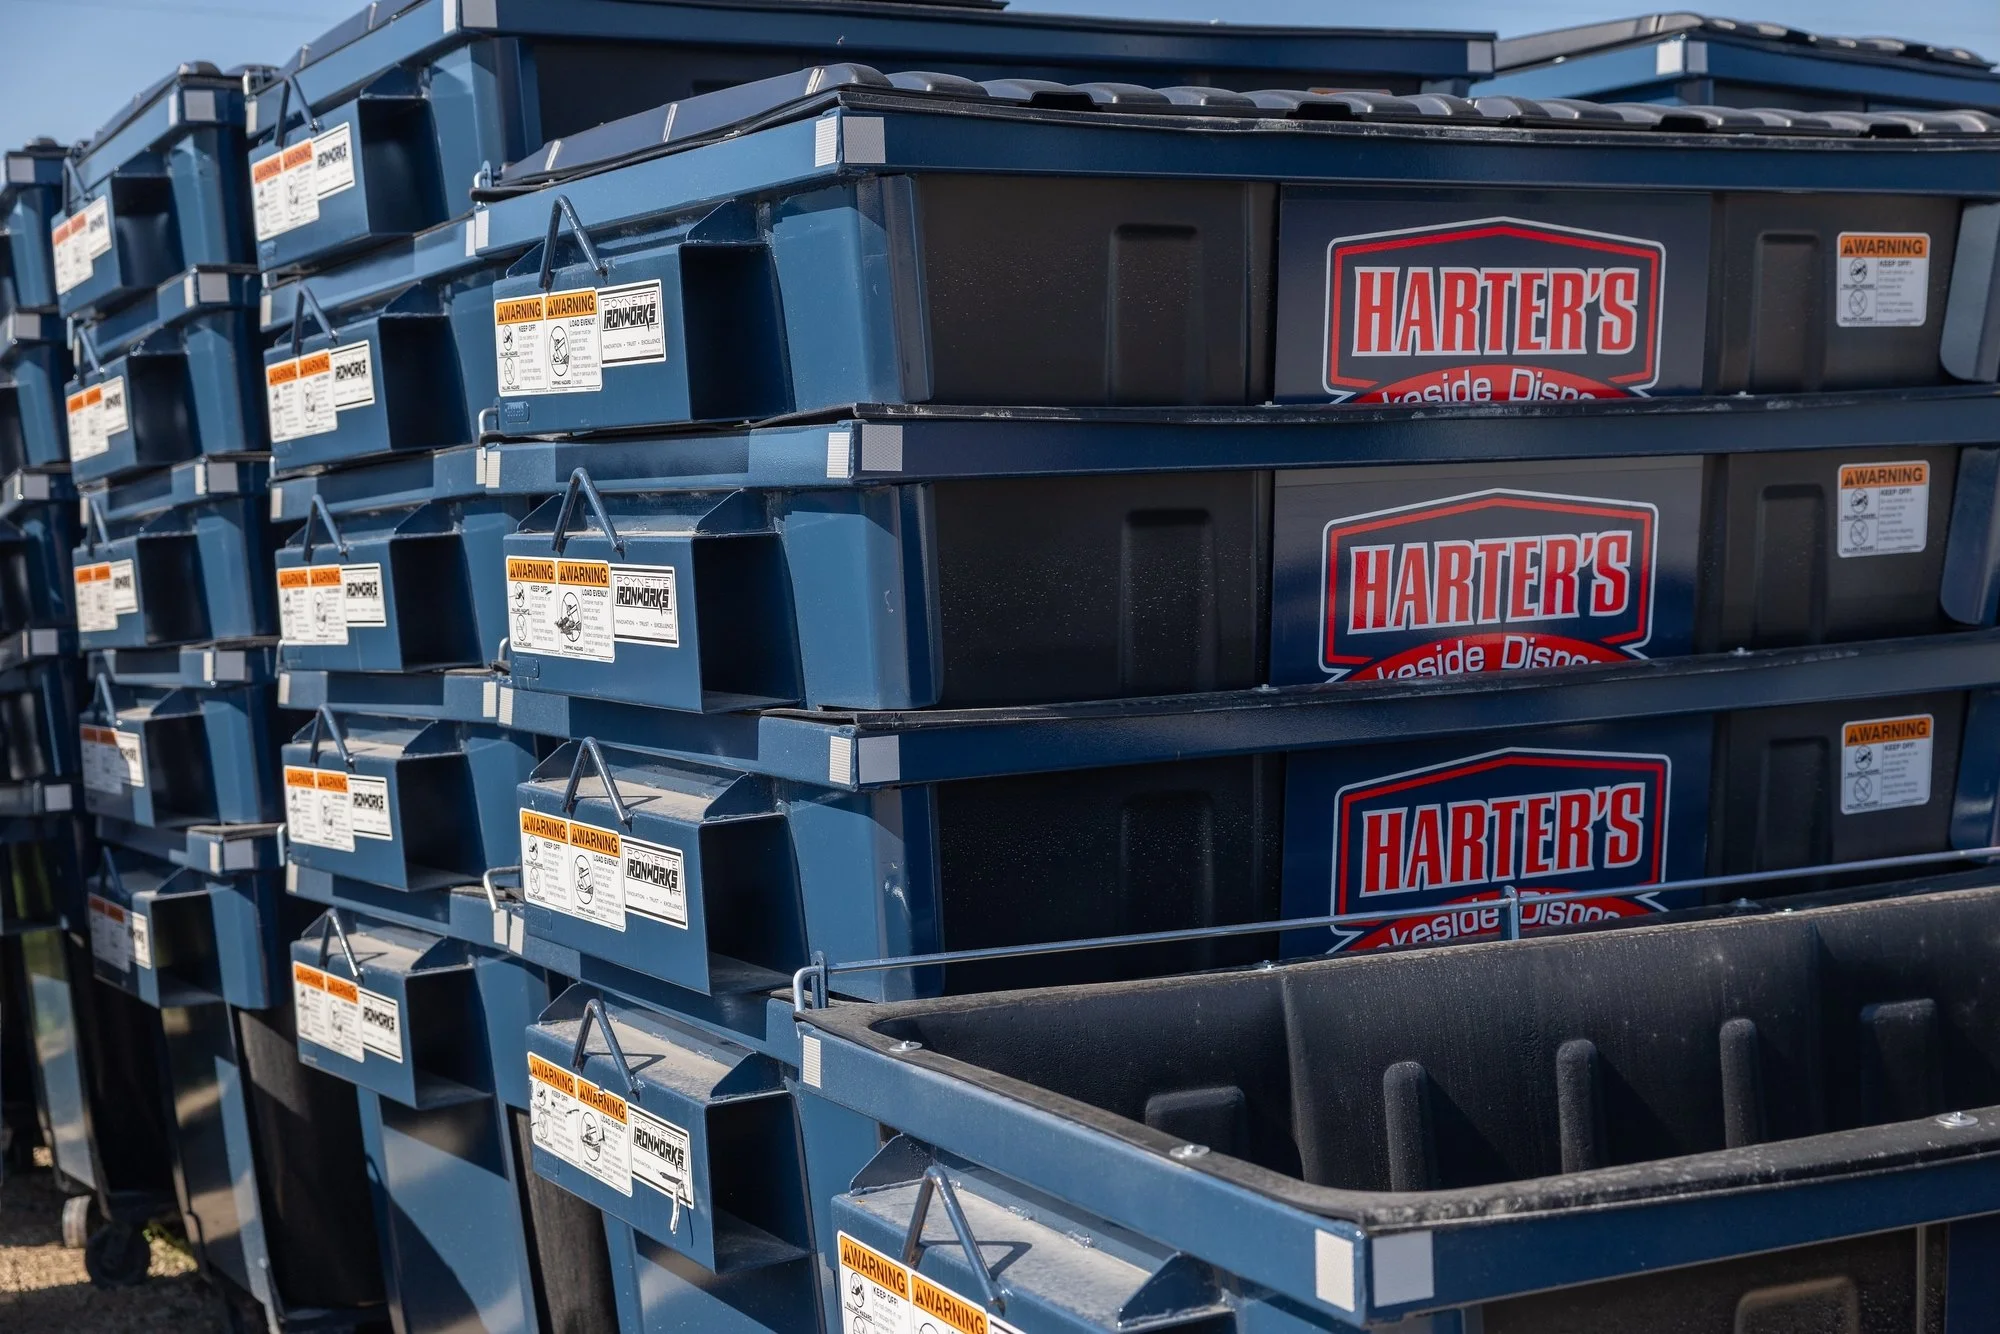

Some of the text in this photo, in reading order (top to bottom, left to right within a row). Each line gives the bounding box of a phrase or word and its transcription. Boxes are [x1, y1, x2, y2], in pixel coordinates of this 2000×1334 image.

[1853, 239, 1923, 255] WARNING
[503, 305, 542, 319] WARNING
[552, 298, 595, 315] WARNING
[604, 293, 656, 309] POYNETTE
[1352, 267, 1640, 356] HARTER'S
[603, 303, 656, 331] IRONWORKS
[1855, 467, 1923, 485] WARNING
[515, 562, 553, 580] WARNING
[564, 565, 608, 584] WARNING
[616, 576, 670, 589] POYNETTE
[1347, 530, 1632, 635] HARTER'S
[616, 586, 670, 612] IRONWORKS
[1501, 635, 1602, 670] Dispo
[1858, 721, 1927, 741] WARNING
[528, 816, 566, 840] WARNING
[1359, 782, 1645, 897] HARTER'S
[576, 829, 619, 853] WARNING
[627, 850, 678, 870] POYNETTE
[626, 858, 678, 892] IRONWORKS
[1376, 897, 1500, 948] keside
[535, 1061, 574, 1093] WARNING
[584, 1087, 625, 1120] WARNING
[633, 1126, 685, 1168] IRONWORKS
[850, 1247, 906, 1295] WARNING
[873, 1286, 886, 1300] KEEP
[922, 1287, 985, 1334] WARNING
